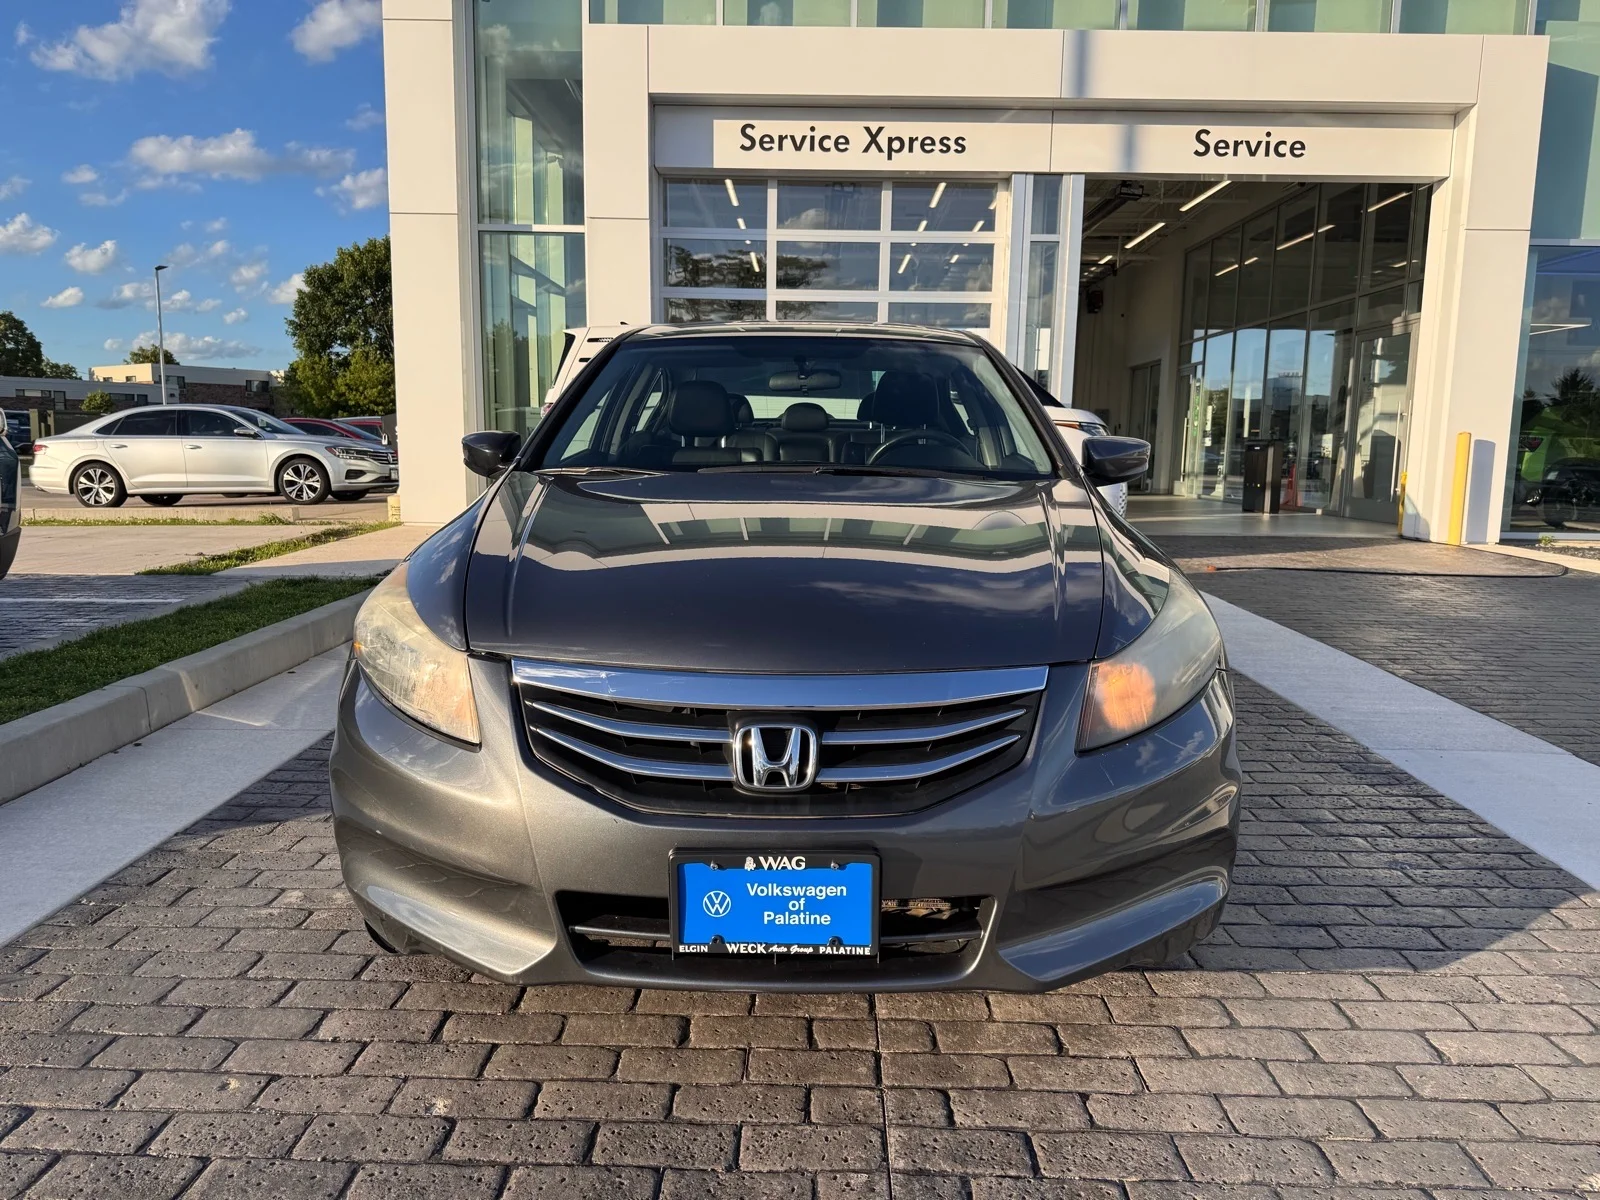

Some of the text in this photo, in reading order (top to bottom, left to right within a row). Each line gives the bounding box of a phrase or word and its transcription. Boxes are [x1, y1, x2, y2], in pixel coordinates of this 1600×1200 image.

[739, 123, 967, 161] Service Xpress
[1193, 128, 1307, 159] Service
[759, 856, 806, 870] WAG
[746, 883, 847, 899] Volkswagen
[788, 898, 806, 911] of
[763, 911, 831, 925] Palatine
[679, 945, 709, 953] ELGIN
[726, 943, 814, 954] WECK Auto Group
[819, 945, 871, 955] PALATINE
